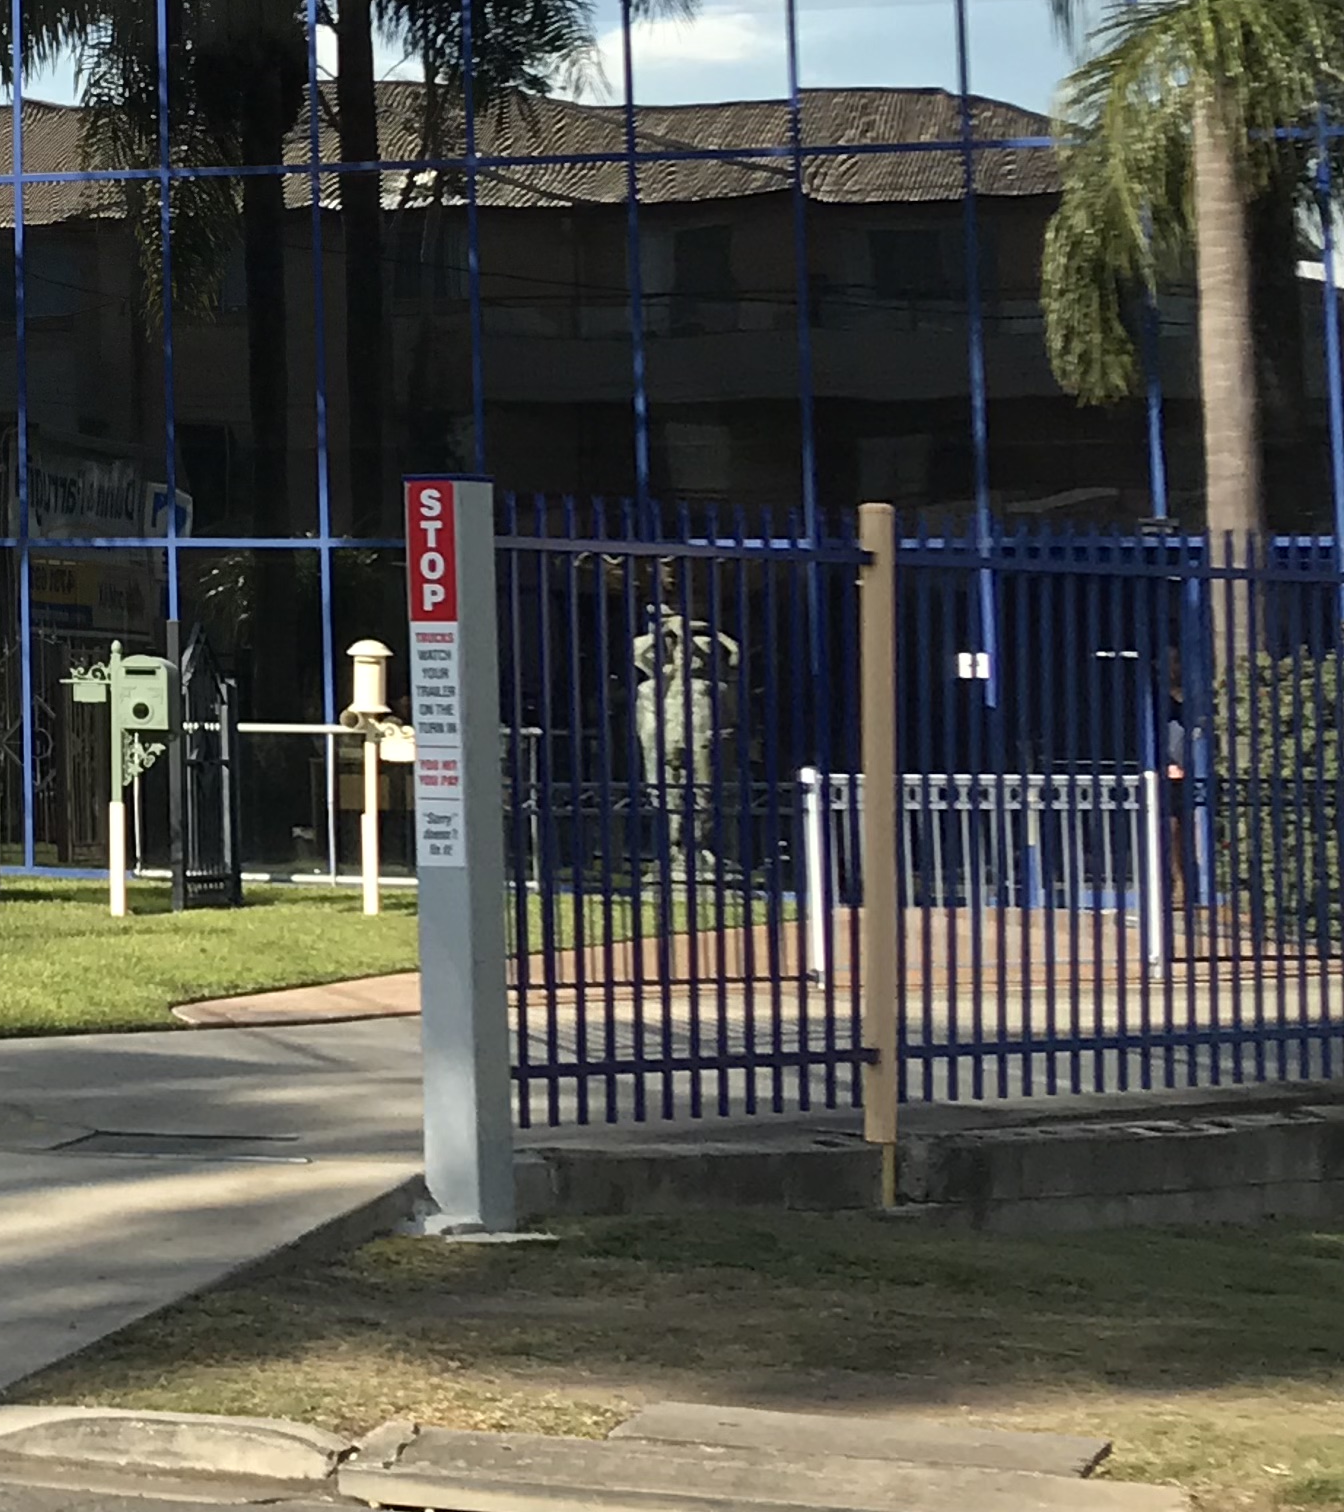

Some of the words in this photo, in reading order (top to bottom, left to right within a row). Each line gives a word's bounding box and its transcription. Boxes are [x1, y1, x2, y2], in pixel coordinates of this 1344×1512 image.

[419, 488, 445, 611] STOP
[417, 649, 452, 661] WATCH
[421, 667, 450, 679] YOUR
[416, 685, 456, 697] TRAILER
[419, 704, 433, 716] ON
[435, 704, 455, 716] THE
